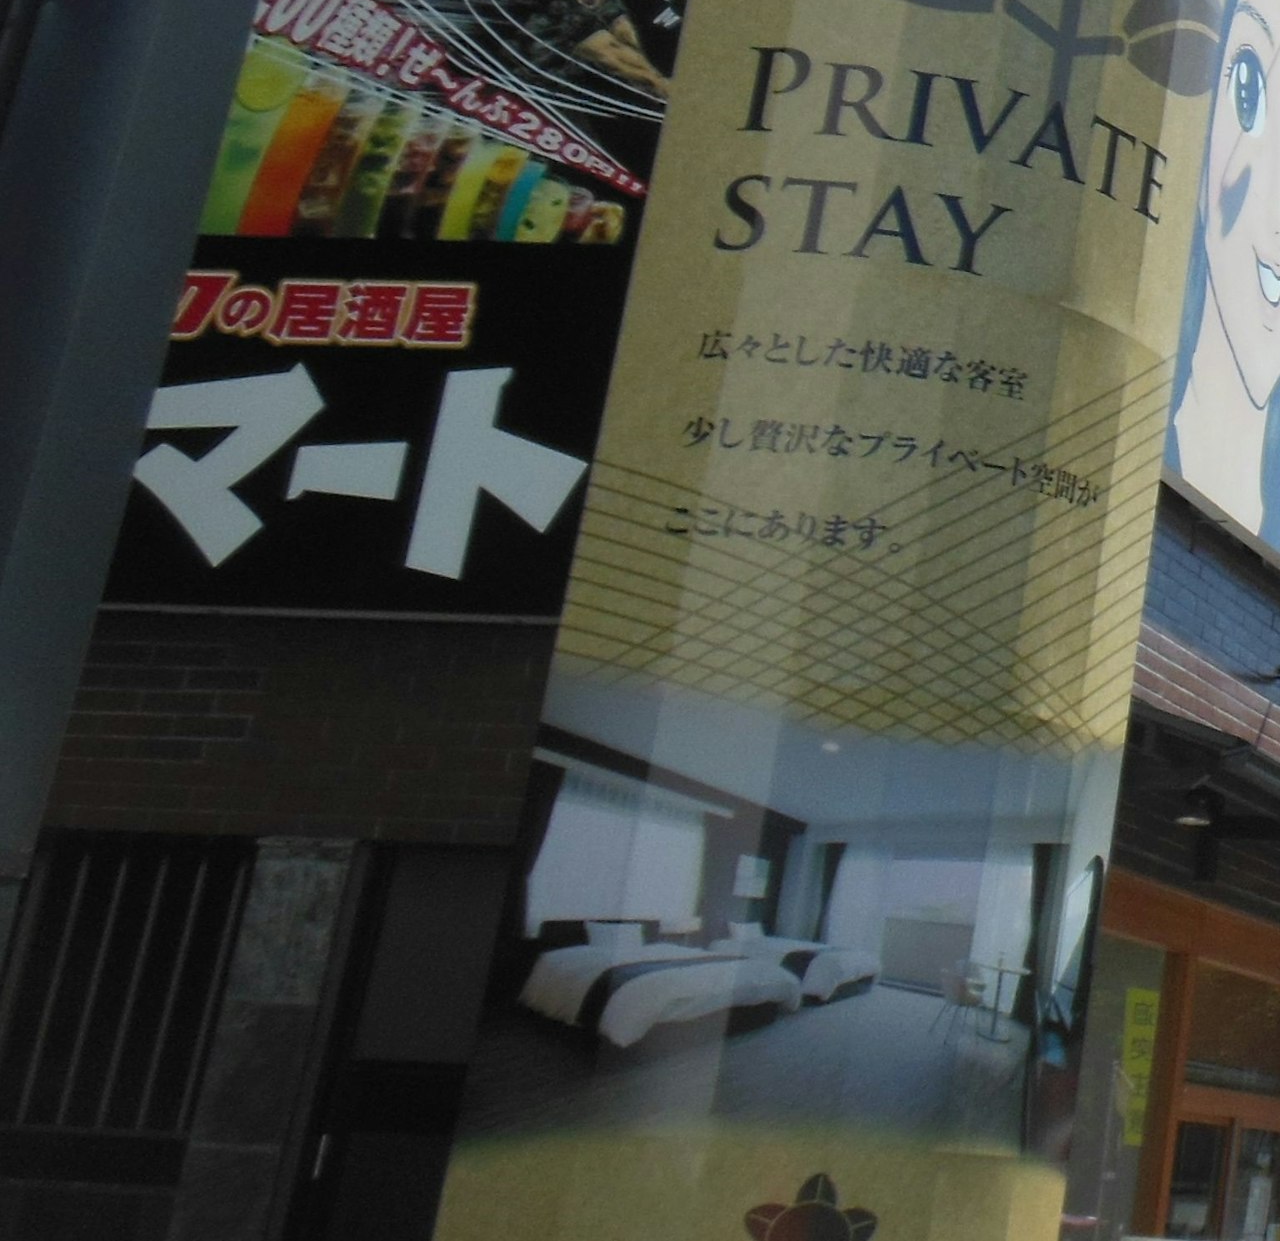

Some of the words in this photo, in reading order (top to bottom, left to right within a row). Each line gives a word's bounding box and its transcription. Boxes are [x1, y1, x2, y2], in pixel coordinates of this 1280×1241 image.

[736, 45, 1168, 225] PRIVATE
[713, 173, 1014, 276] STAY
[700, 329, 1029, 401] 広々とした快適な客室
[682, 415, 1099, 507] 少し贅沢なプライベート空間が
[663, 506, 904, 556] ここにあります。
